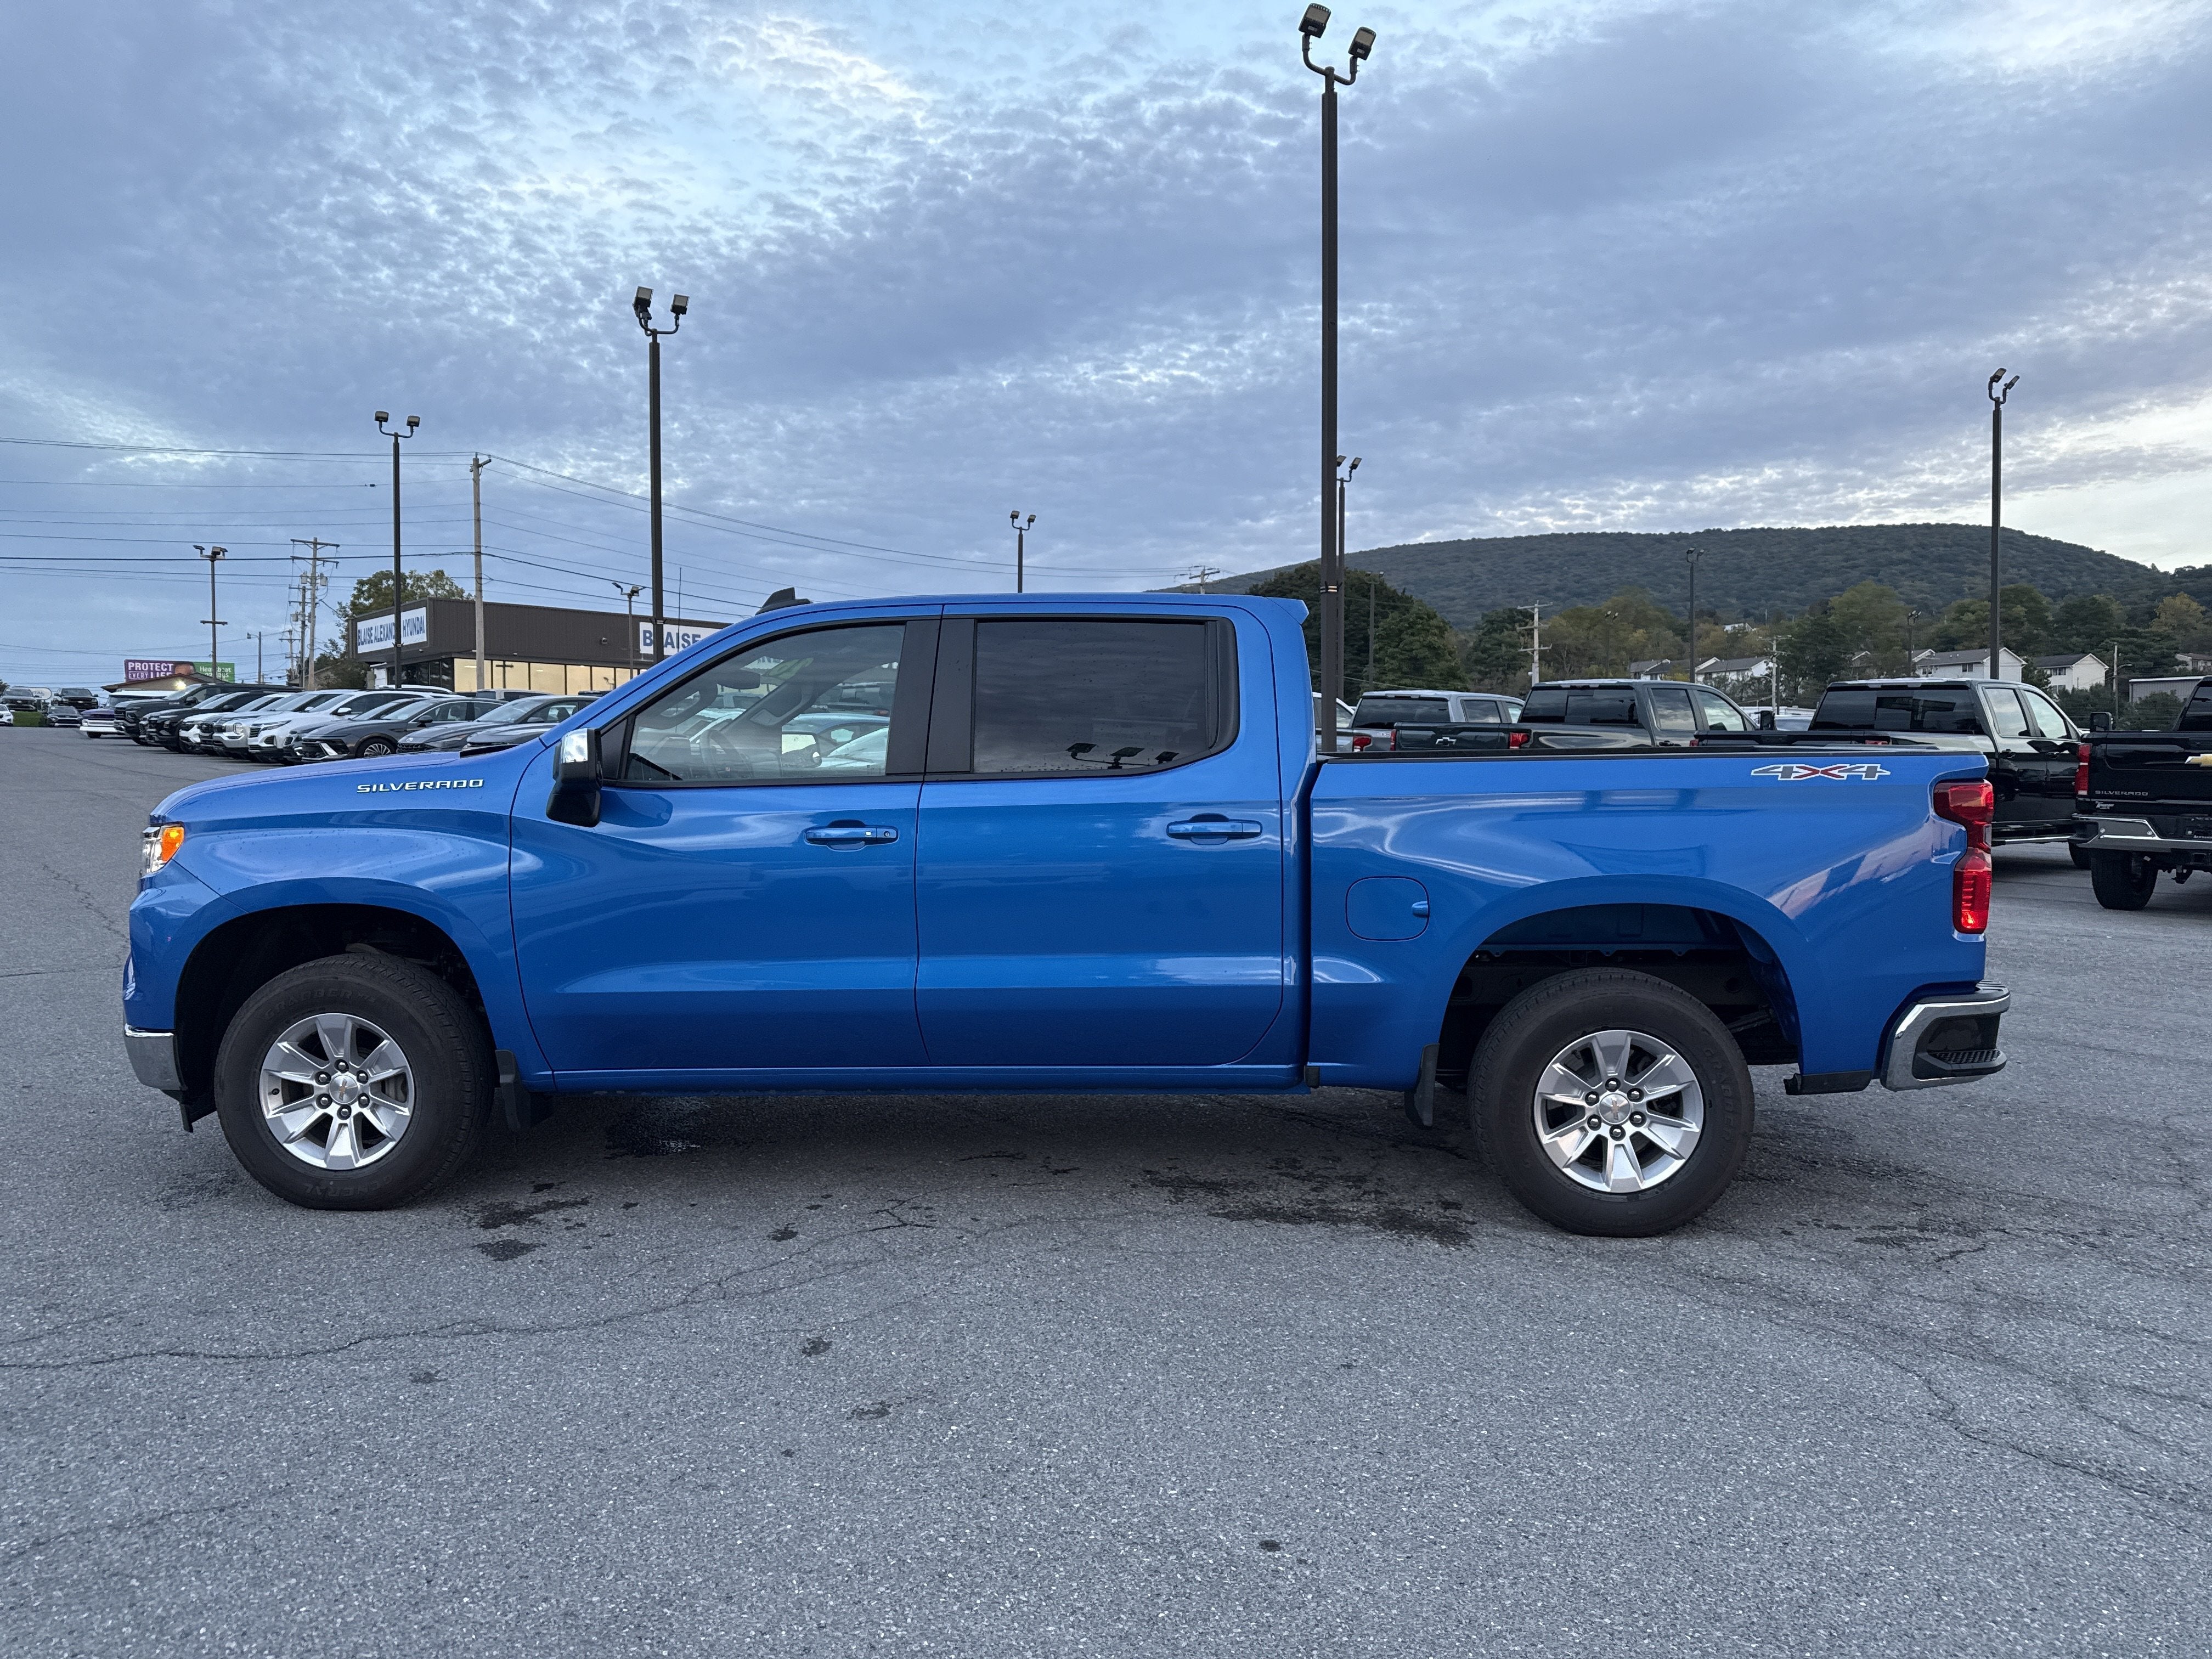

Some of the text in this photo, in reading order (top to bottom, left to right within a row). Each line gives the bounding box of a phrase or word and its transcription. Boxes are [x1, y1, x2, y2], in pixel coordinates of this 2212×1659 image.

[358, 615, 425, 646] BLAISE ALEXAND HYUNDAI
[642, 630, 701, 648] BAIS
[128, 662, 173, 672] PROTECT
[357, 779, 484, 793] SILVERADO
